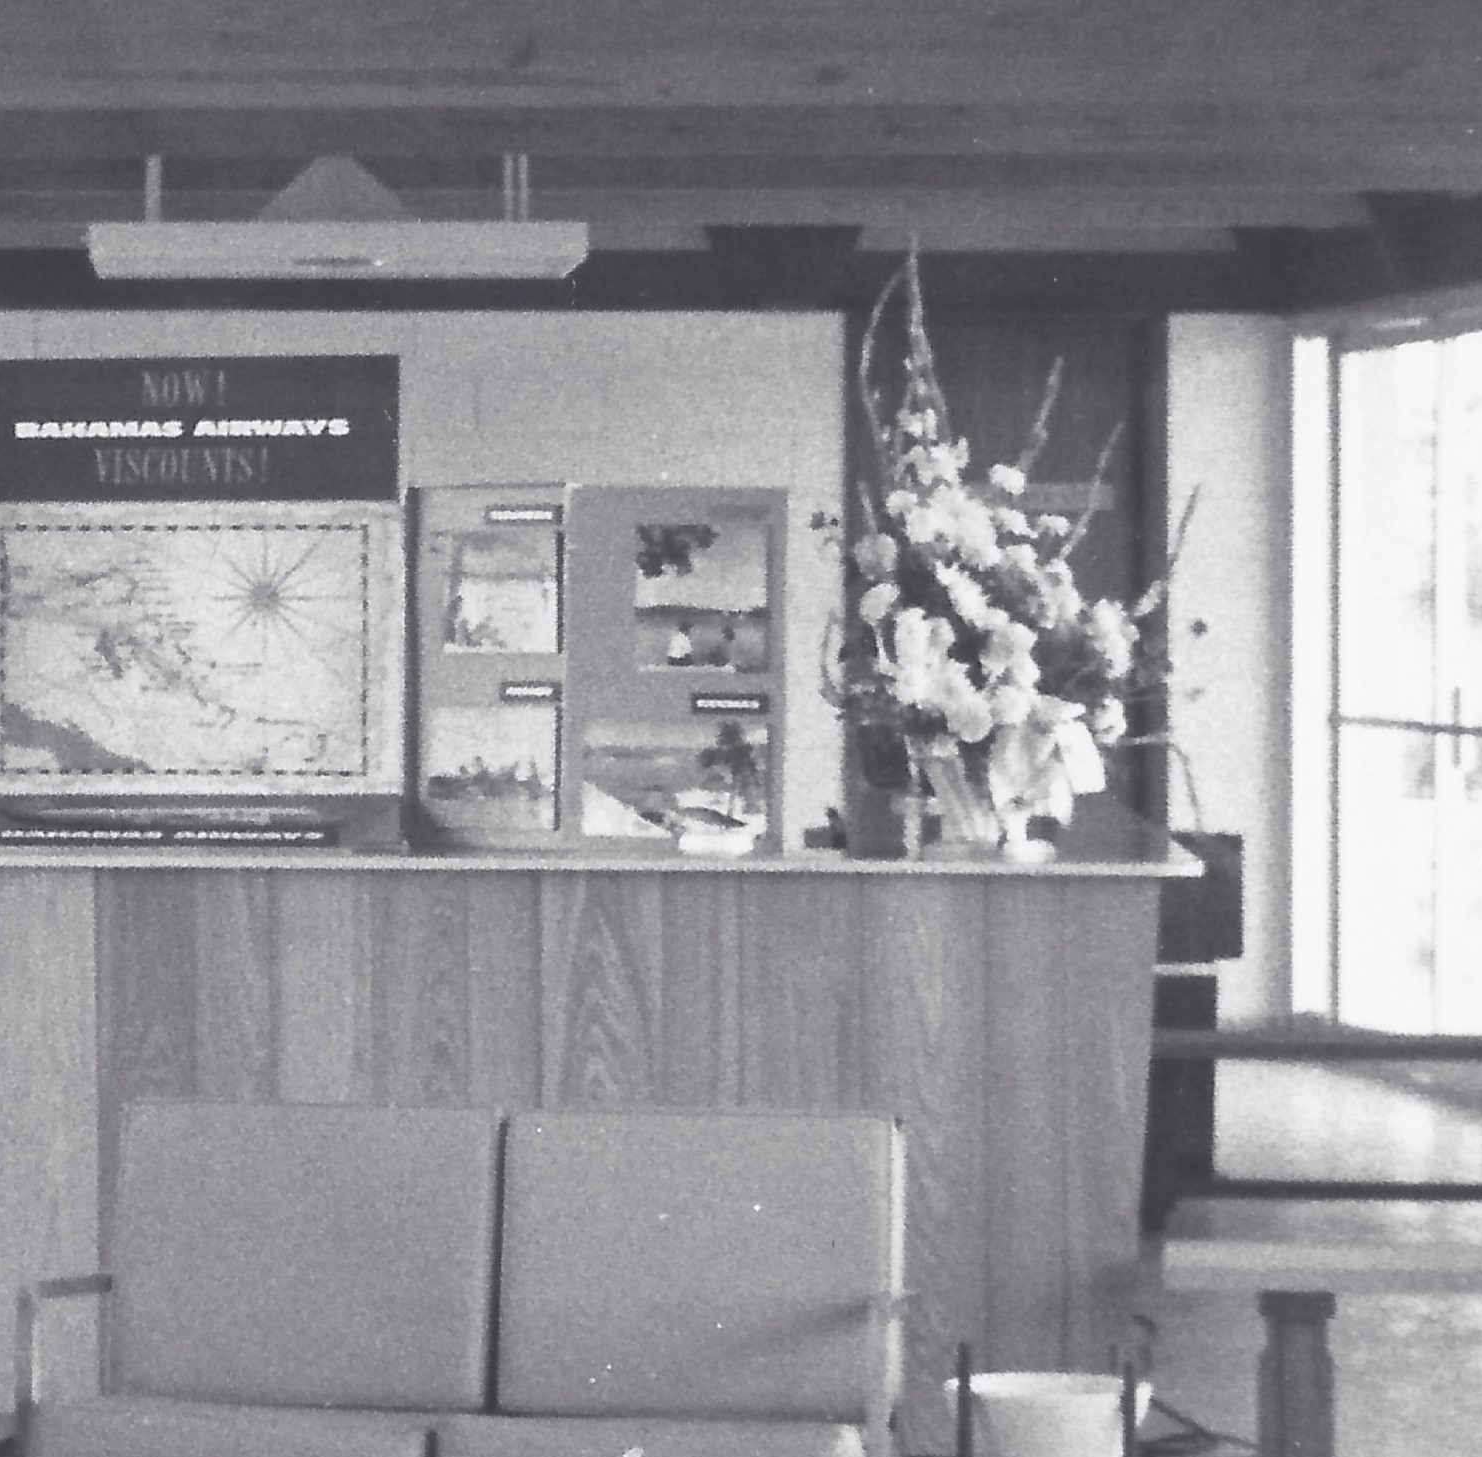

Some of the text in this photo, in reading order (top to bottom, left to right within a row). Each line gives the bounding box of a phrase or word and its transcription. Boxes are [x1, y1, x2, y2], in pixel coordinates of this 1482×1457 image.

[140, 369, 228, 409] NOW!
[13, 417, 350, 440] BAHAMAS AIRWAYS
[94, 446, 269, 485] VISCOUNTS!
